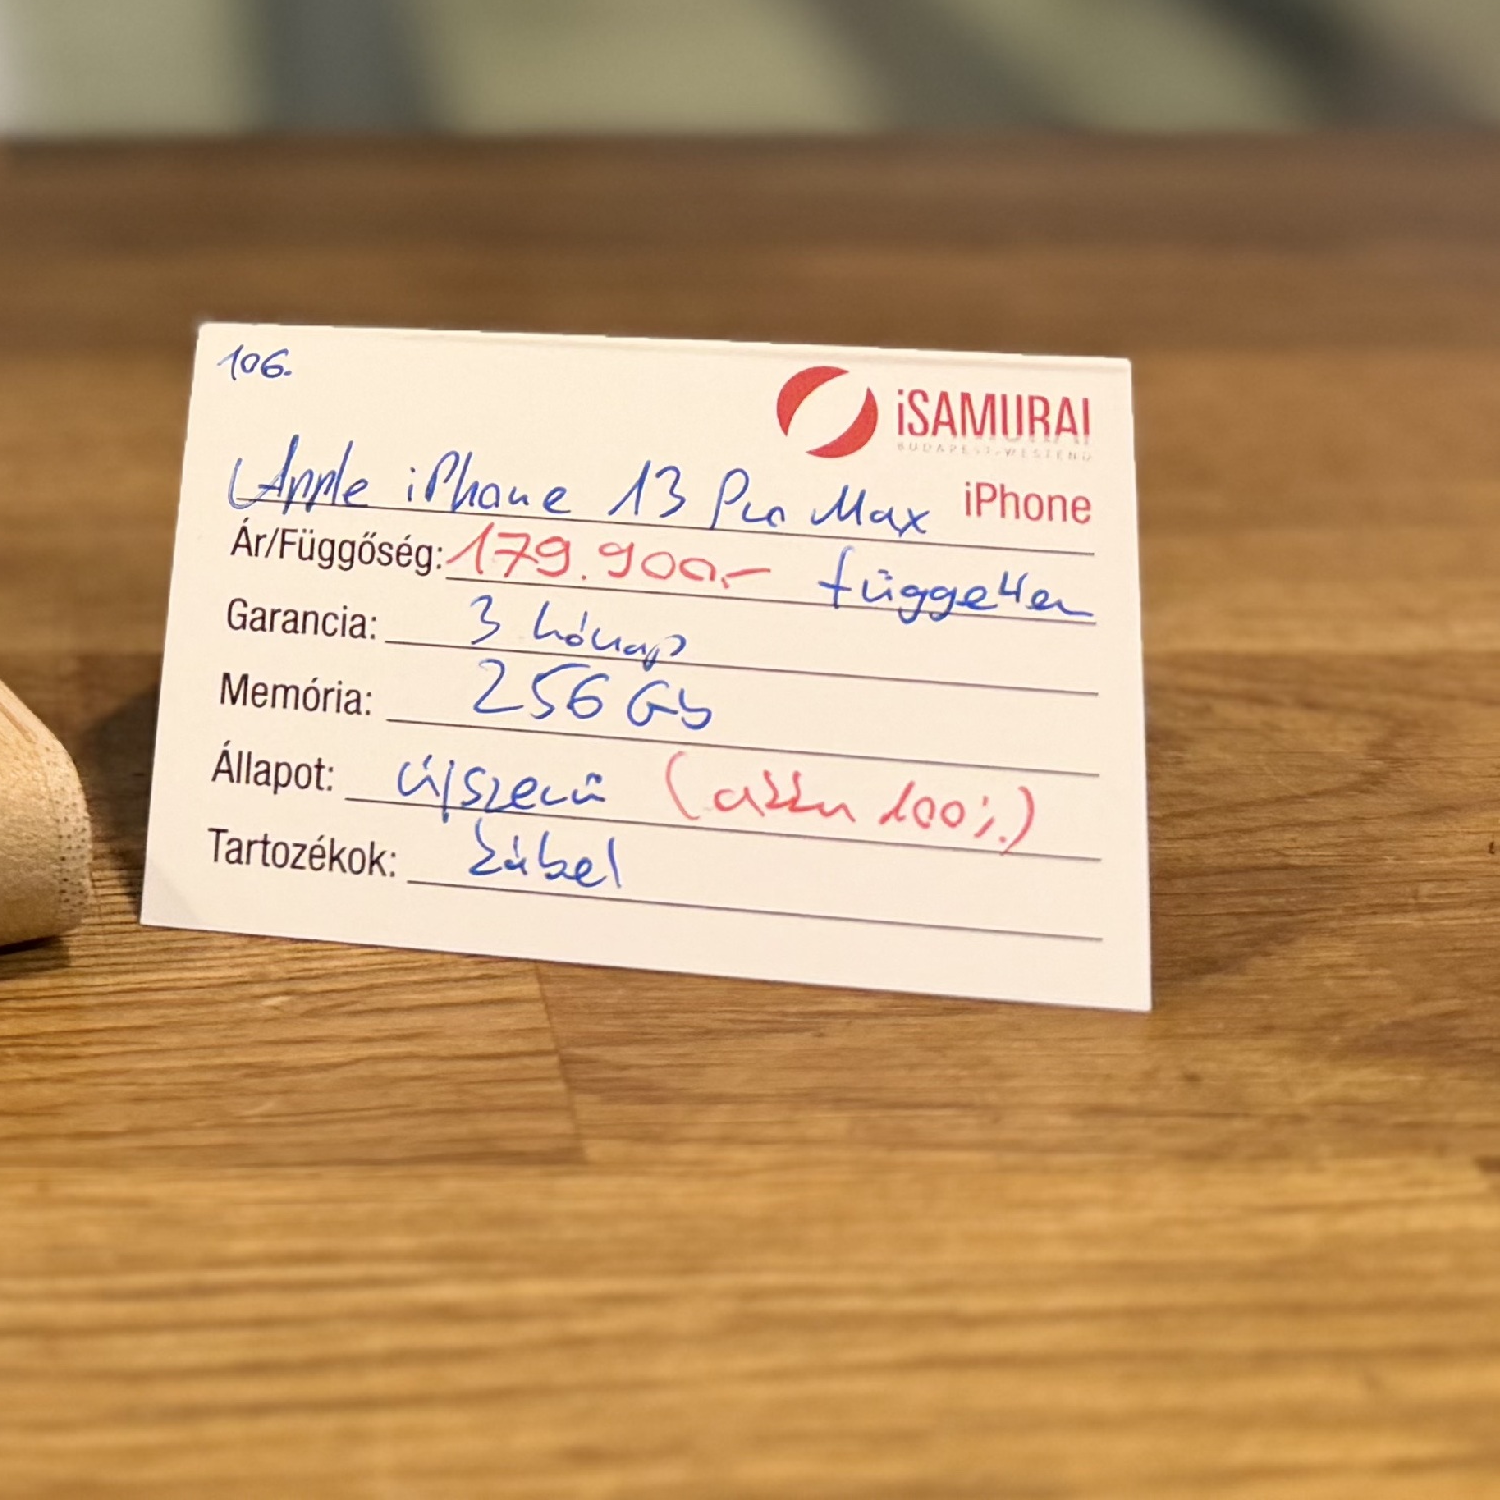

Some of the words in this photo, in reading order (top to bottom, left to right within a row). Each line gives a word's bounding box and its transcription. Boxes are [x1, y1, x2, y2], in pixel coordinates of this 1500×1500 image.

[217, 344, 293, 381] 106.
[897, 388, 1091, 437] iSAMURAI
[229, 435, 369, 516] Apple
[407, 451, 568, 515] iPhone
[608, 460, 687, 519] 13
[711, 468, 786, 529] Pro
[810, 484, 930, 538] Max
[966, 482, 1091, 523] iPhone
[230, 517, 444, 577] Ár/Függőség:
[227, 597, 377, 640] Garancia:
[471, 594, 501, 645] 3
[533, 600, 687, 672] hónap
[220, 672, 372, 716] Memória:
[472, 658, 611, 721] 256
[211, 740, 334, 795] Állapot:
[207, 827, 396, 877] Tartozékok:
[468, 819, 621, 889] kábel
